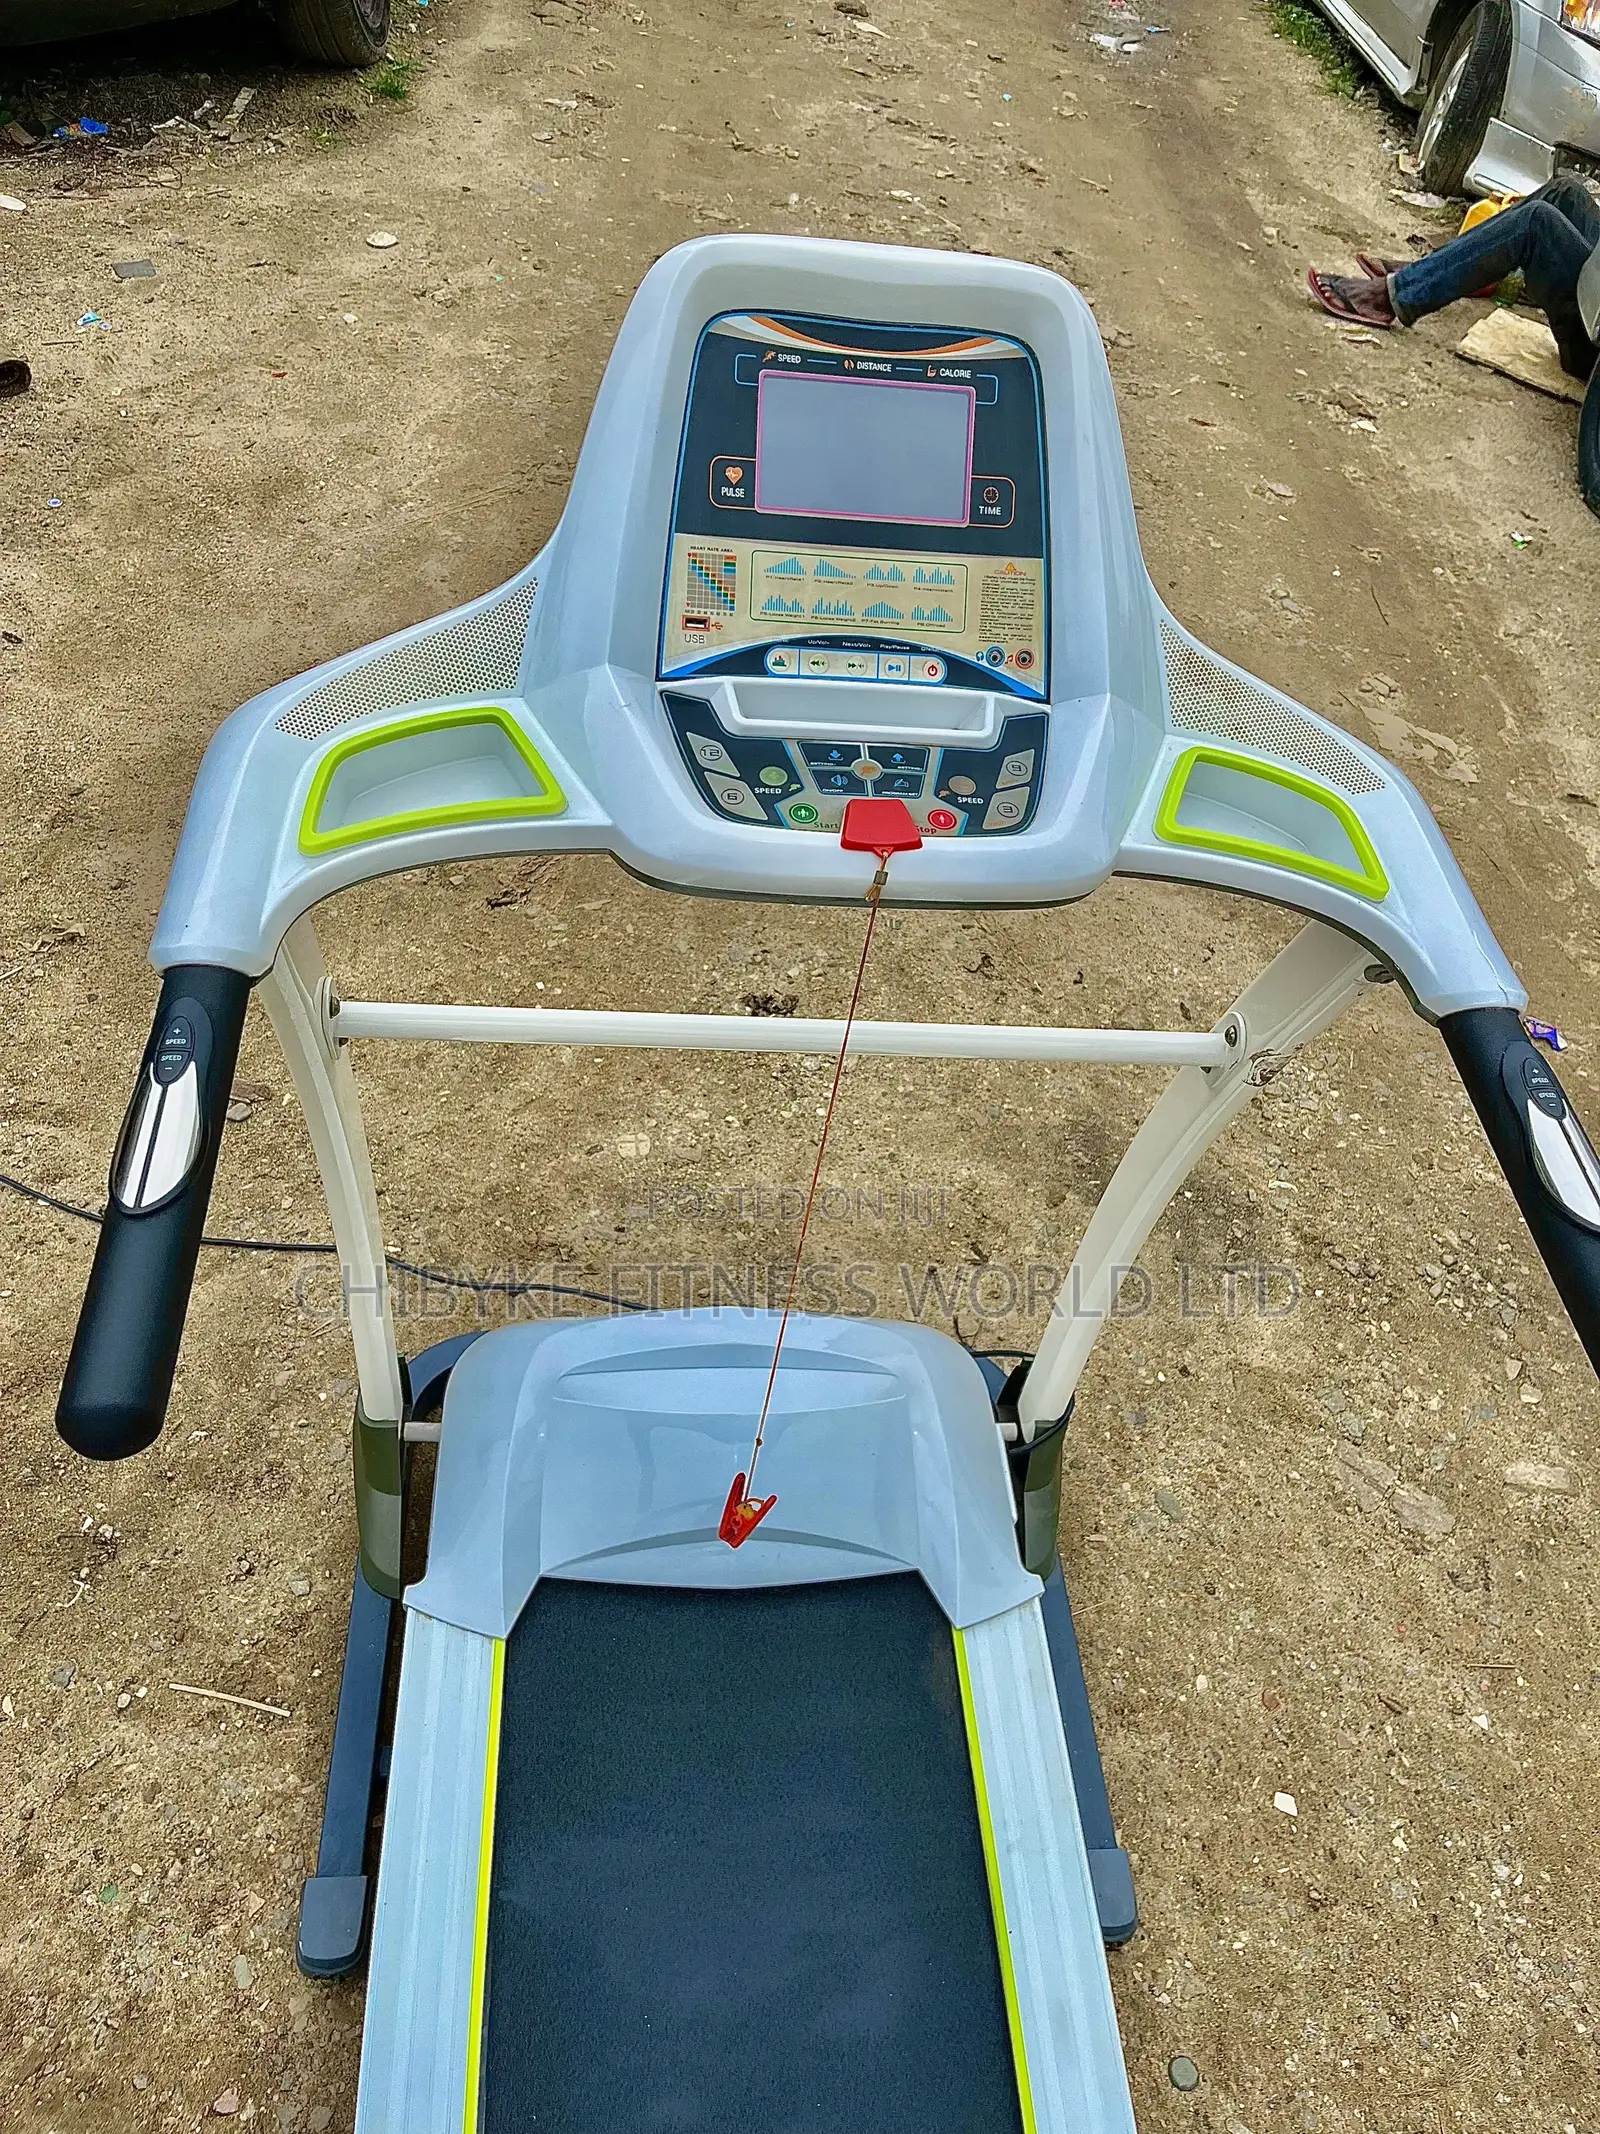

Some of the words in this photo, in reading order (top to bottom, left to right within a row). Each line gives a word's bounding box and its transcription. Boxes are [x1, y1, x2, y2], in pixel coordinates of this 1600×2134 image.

[777, 353, 801, 364] SPEED
[856, 361, 892, 373] DISTANCE
[939, 367, 972, 379] CALORIE
[721, 486, 745, 498] PULSE
[978, 505, 1002, 516] TIME
[993, 569, 1027, 577] CAUTION
[684, 633, 705, 644] USB
[702, 749, 720, 757] 12
[754, 786, 782, 795] SPEED
[727, 792, 738, 801] 6
[957, 796, 984, 805] SPEED
[1002, 805, 1014, 813] 3
[813, 821, 839, 829] Start
